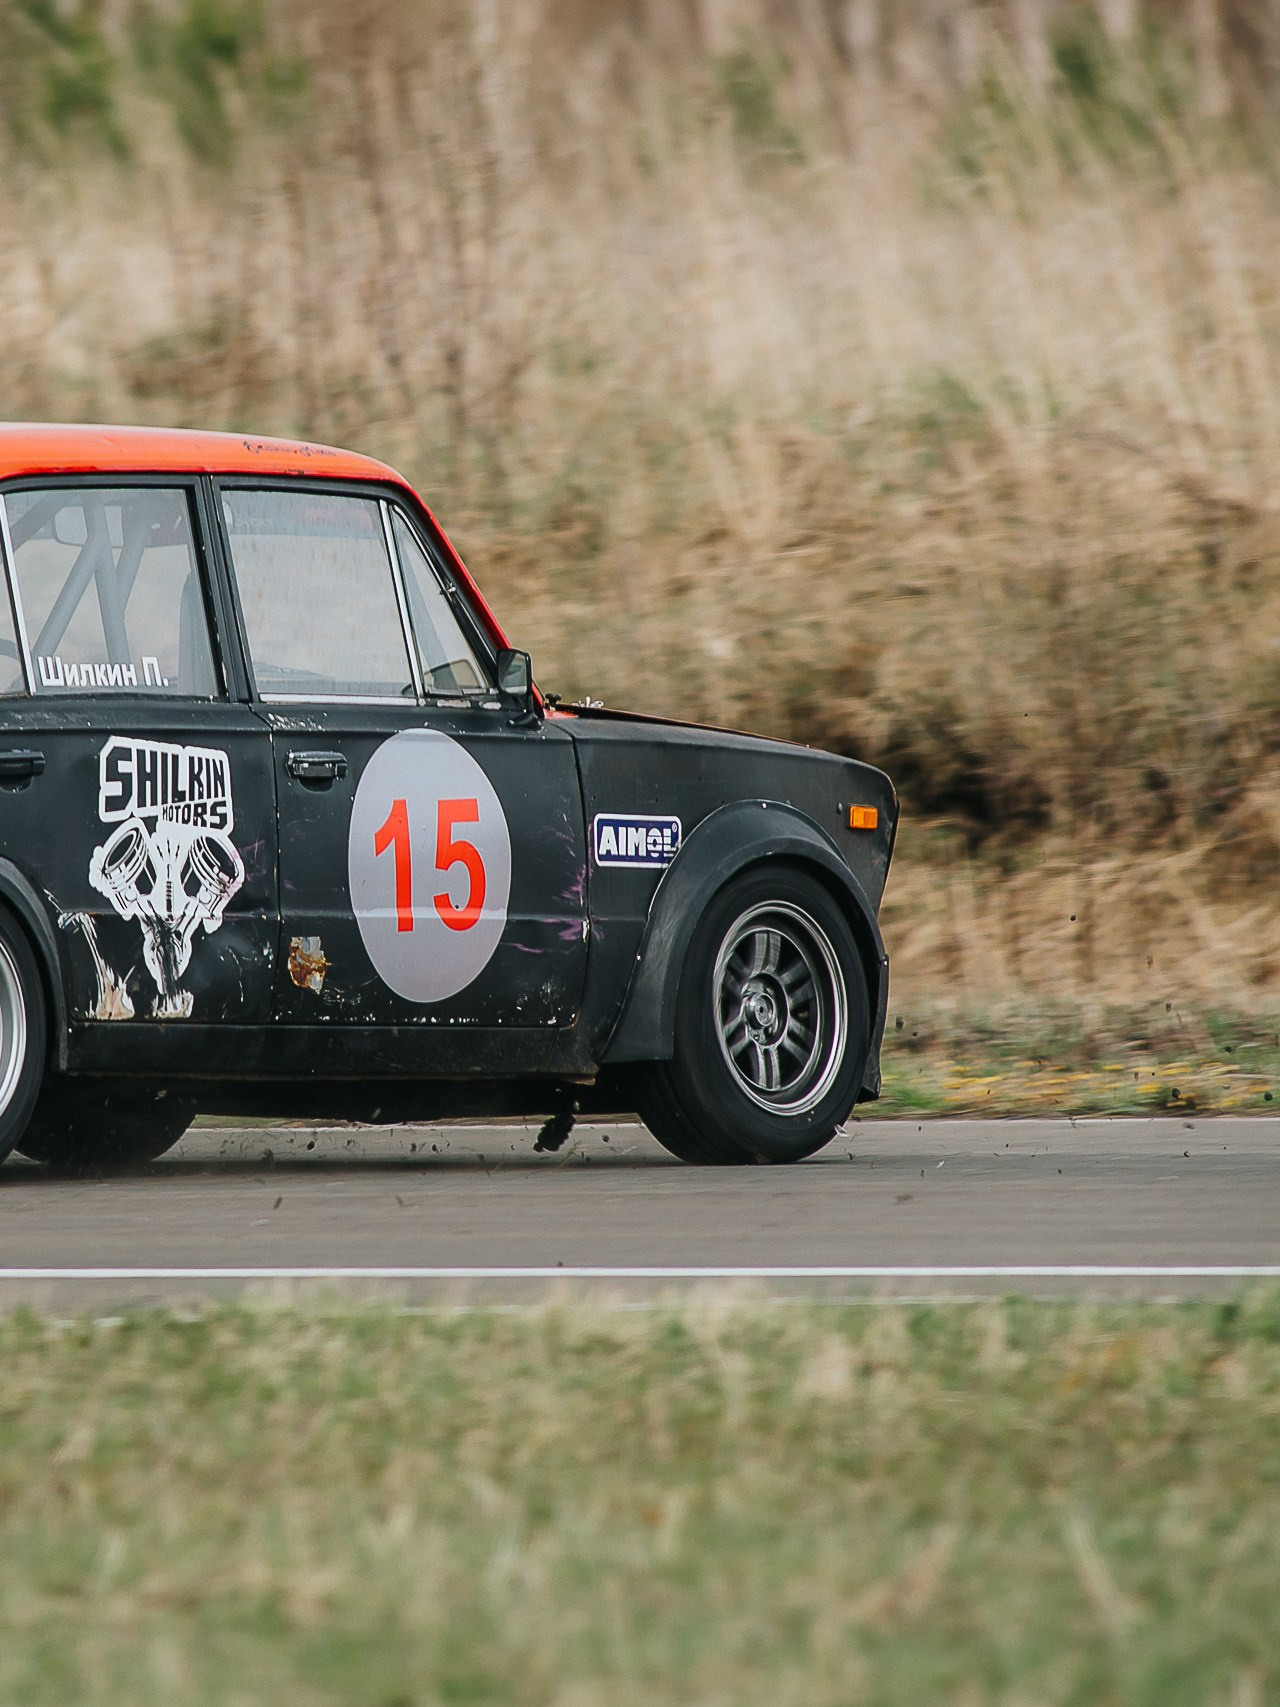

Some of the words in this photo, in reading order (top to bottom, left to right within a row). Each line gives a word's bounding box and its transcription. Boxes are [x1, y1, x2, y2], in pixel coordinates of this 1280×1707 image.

[37, 656, 138, 687] Шилкин
[141, 656, 169, 687] П.
[104, 745, 226, 813] SHILKIN
[162, 800, 228, 830] MOTORS
[374, 798, 487, 932] 15
